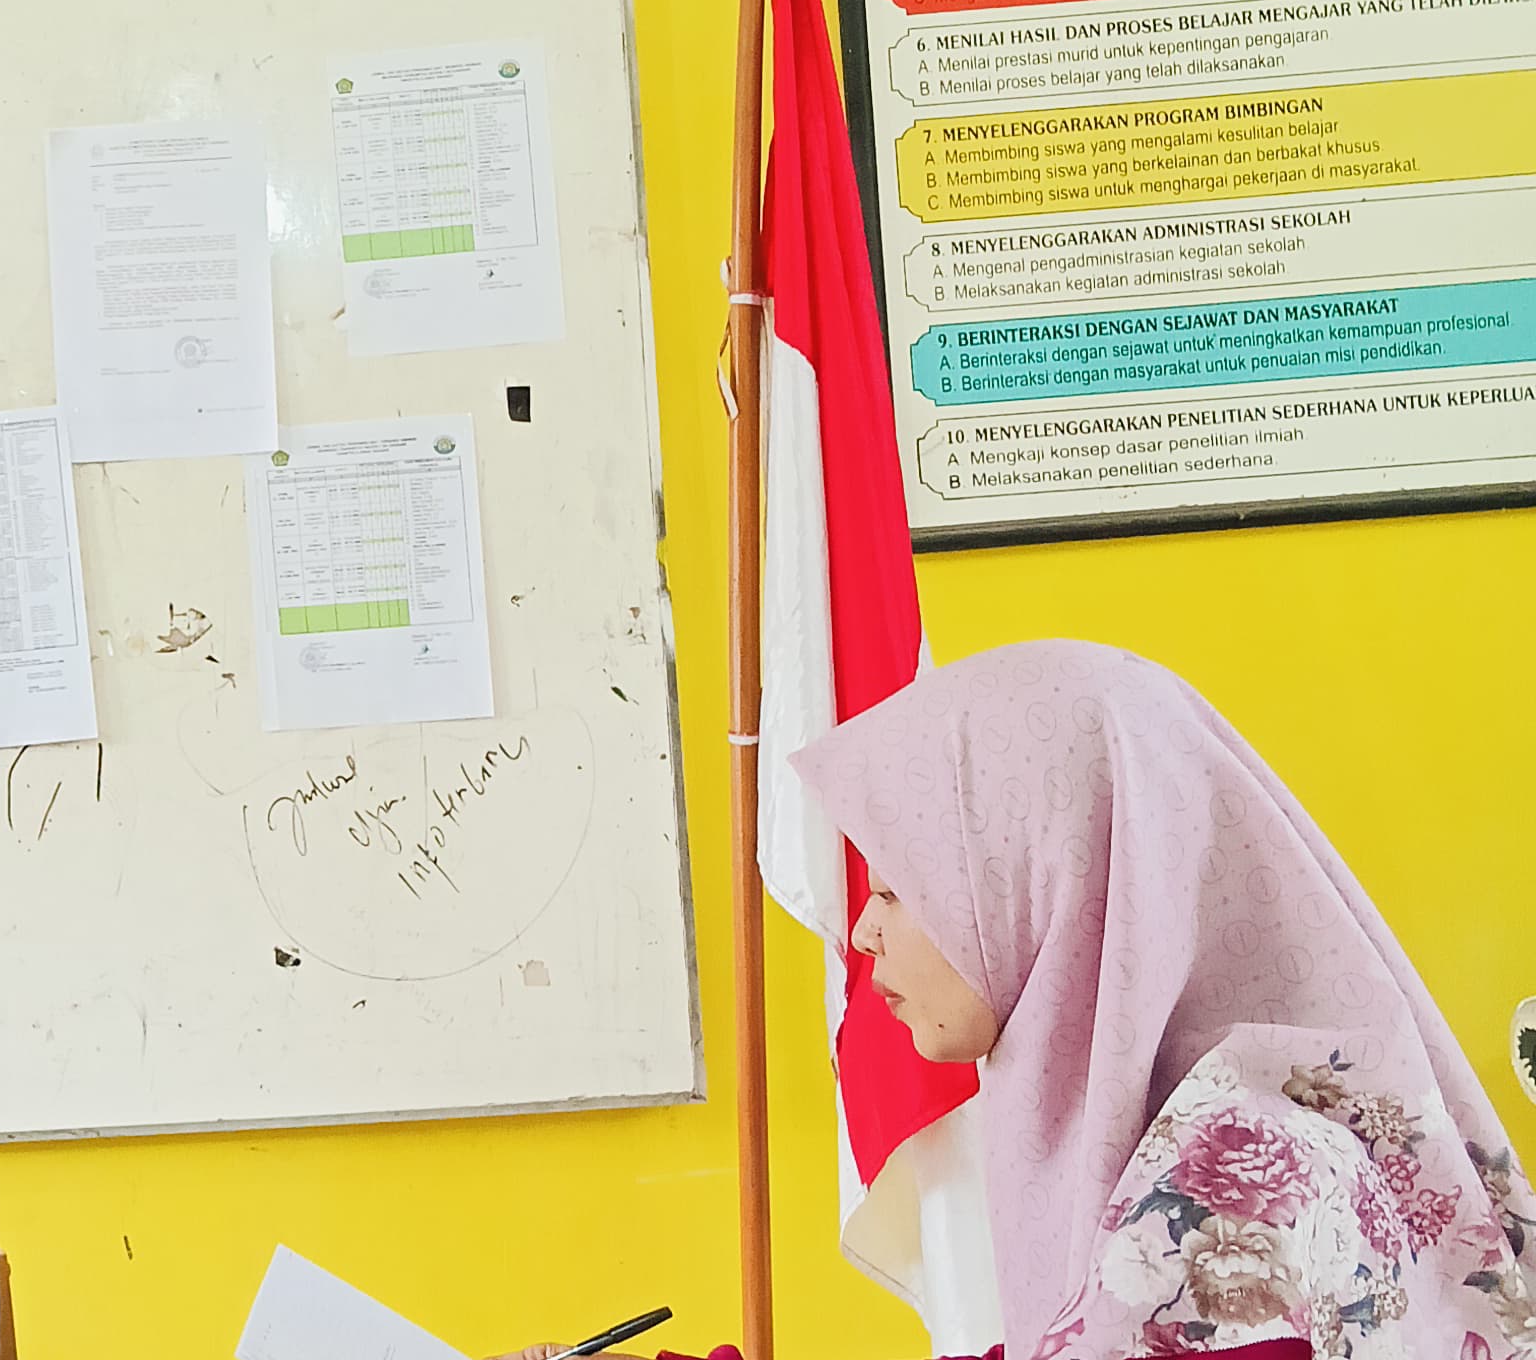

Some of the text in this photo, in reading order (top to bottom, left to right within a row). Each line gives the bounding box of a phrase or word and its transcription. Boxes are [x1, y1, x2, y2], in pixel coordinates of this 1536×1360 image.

[916, 37, 930, 52] 6.
[936, 30, 1004, 51] MENILAI
[1010, 26, 1056, 44] HASIL
[1065, 22, 1101, 40] DAN
[1106, 16, 1173, 36] PROSES
[1178, 9, 1253, 31] BELAJAR
[1258, 1, 1352, 23] MENGAJAR
[923, 97, 1323, 144] 7. MENYELENGGARAKAN PROGRAM BIMBINGAN
[945, 143, 1040, 164] Membimbing
[1044, 141, 1086, 157] siswa
[1090, 138, 1126, 157] yang
[1131, 130, 1213, 151] mengalami
[1217, 124, 1284, 143] kesulitan
[949, 188, 1044, 209] Membimbing
[1048, 186, 1090, 201] siswa
[1094, 178, 1135, 198] untuk
[1140, 174, 1228, 195] menghargai
[1233, 168, 1307, 190] pekerjaan
[1311, 163, 1325, 179] di
[931, 209, 1351, 257] 8. MENYELENGGARAKAN ADMINISTRASI SEKOLAH
[937, 297, 1399, 348] 9. BERINTERAKSI DENGAN SEJAWAT DAN MASYARAKAT
[939, 353, 955, 371] A.
[959, 347, 1048, 369] Berinteraksi
[1051, 345, 1108, 365] dengan
[1112, 338, 1170, 361] sejawat
[1173, 332, 1217, 353] untuk
[1219, 327, 1325, 350] meningkatkan
[1328, 320, 1422, 340] kemampuan
[941, 376, 957, 393] B.
[961, 369, 1050, 391] Berinteraksi
[1053, 366, 1110, 386] dengan
[1113, 357, 1202, 382] masyarakat
[1205, 353, 1247, 373] untuk
[1325, 345, 1356, 364] misi
[1360, 339, 1446, 364] pendidikan.
[947, 429, 969, 445] 10.
[975, 414, 1162, 442] MENYELENGGARAKAN
[1167, 406, 1266, 428] PENELITIAN
[1272, 398, 1378, 420] SEDERHANA
[1383, 392, 1442, 412] UNTUK
